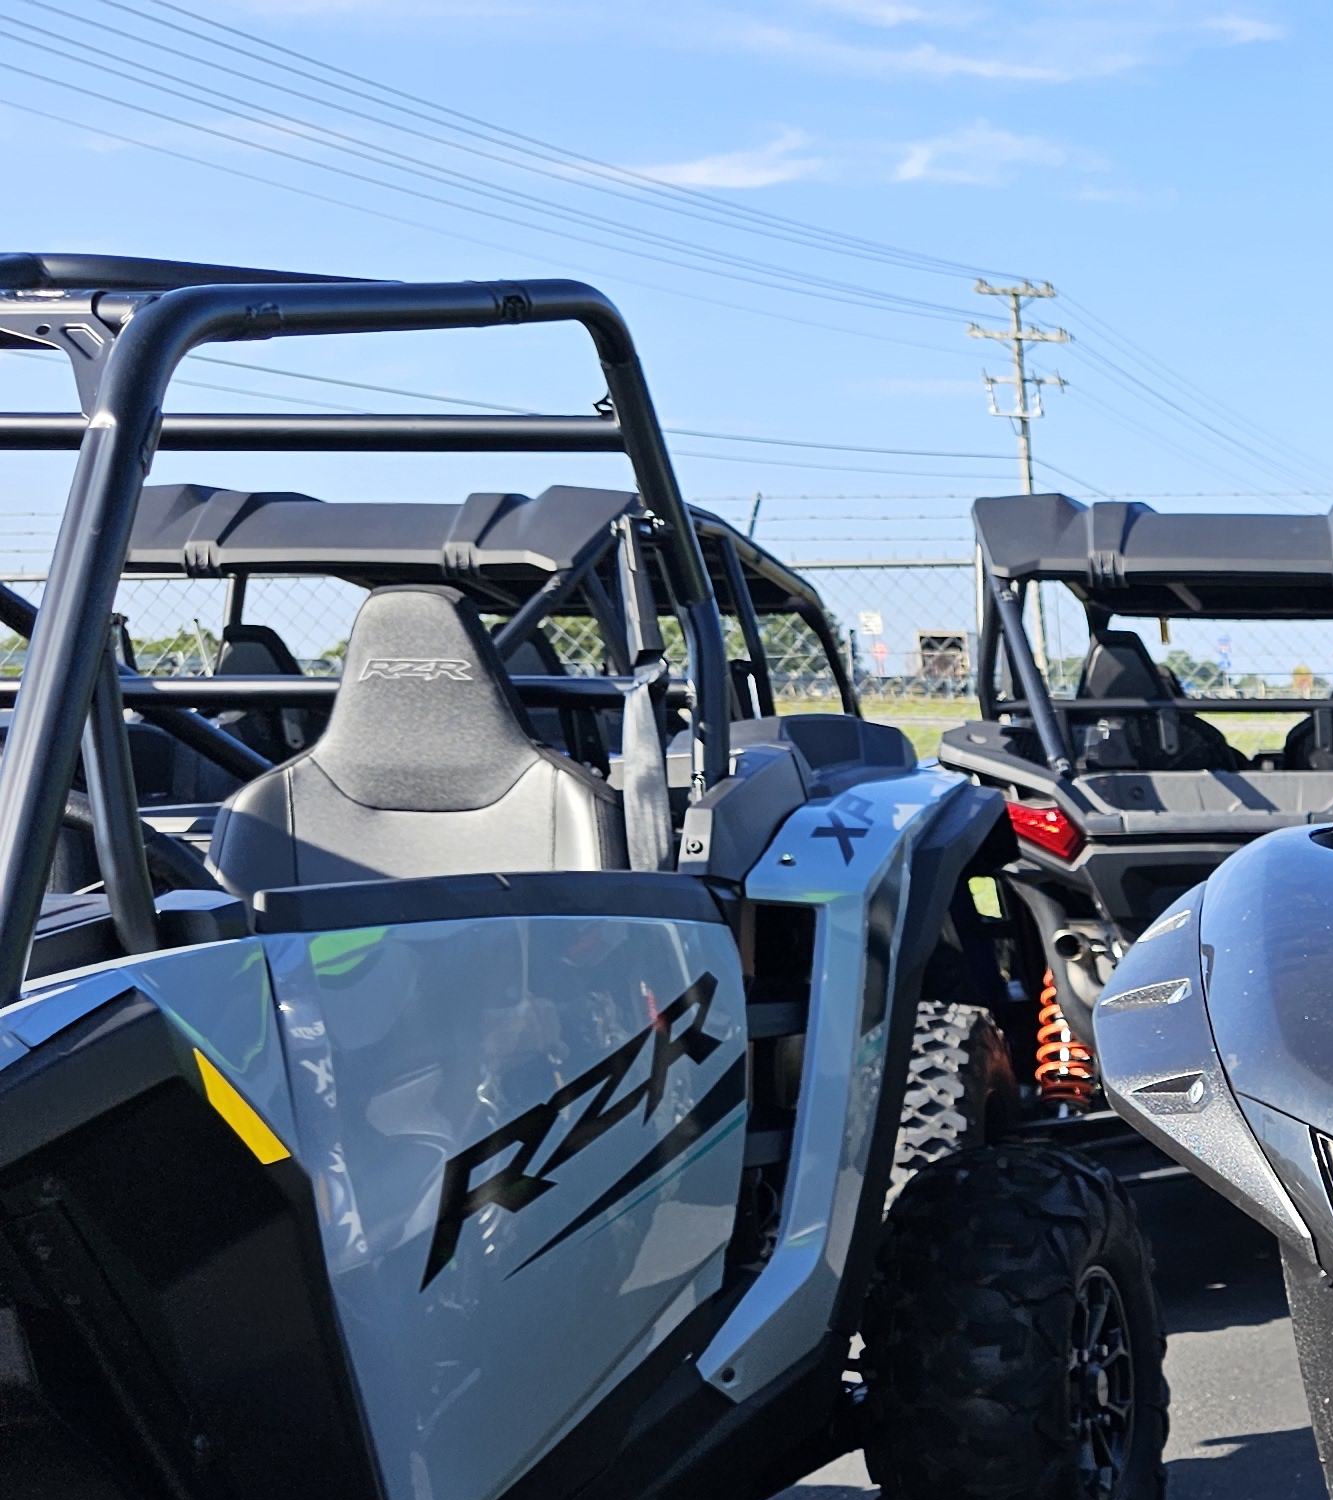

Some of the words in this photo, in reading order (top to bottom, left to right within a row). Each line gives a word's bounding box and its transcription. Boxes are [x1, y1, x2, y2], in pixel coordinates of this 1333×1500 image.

[358, 658, 474, 681] RZR
[809, 793, 875, 867] XP
[419, 971, 723, 1294] RZR
